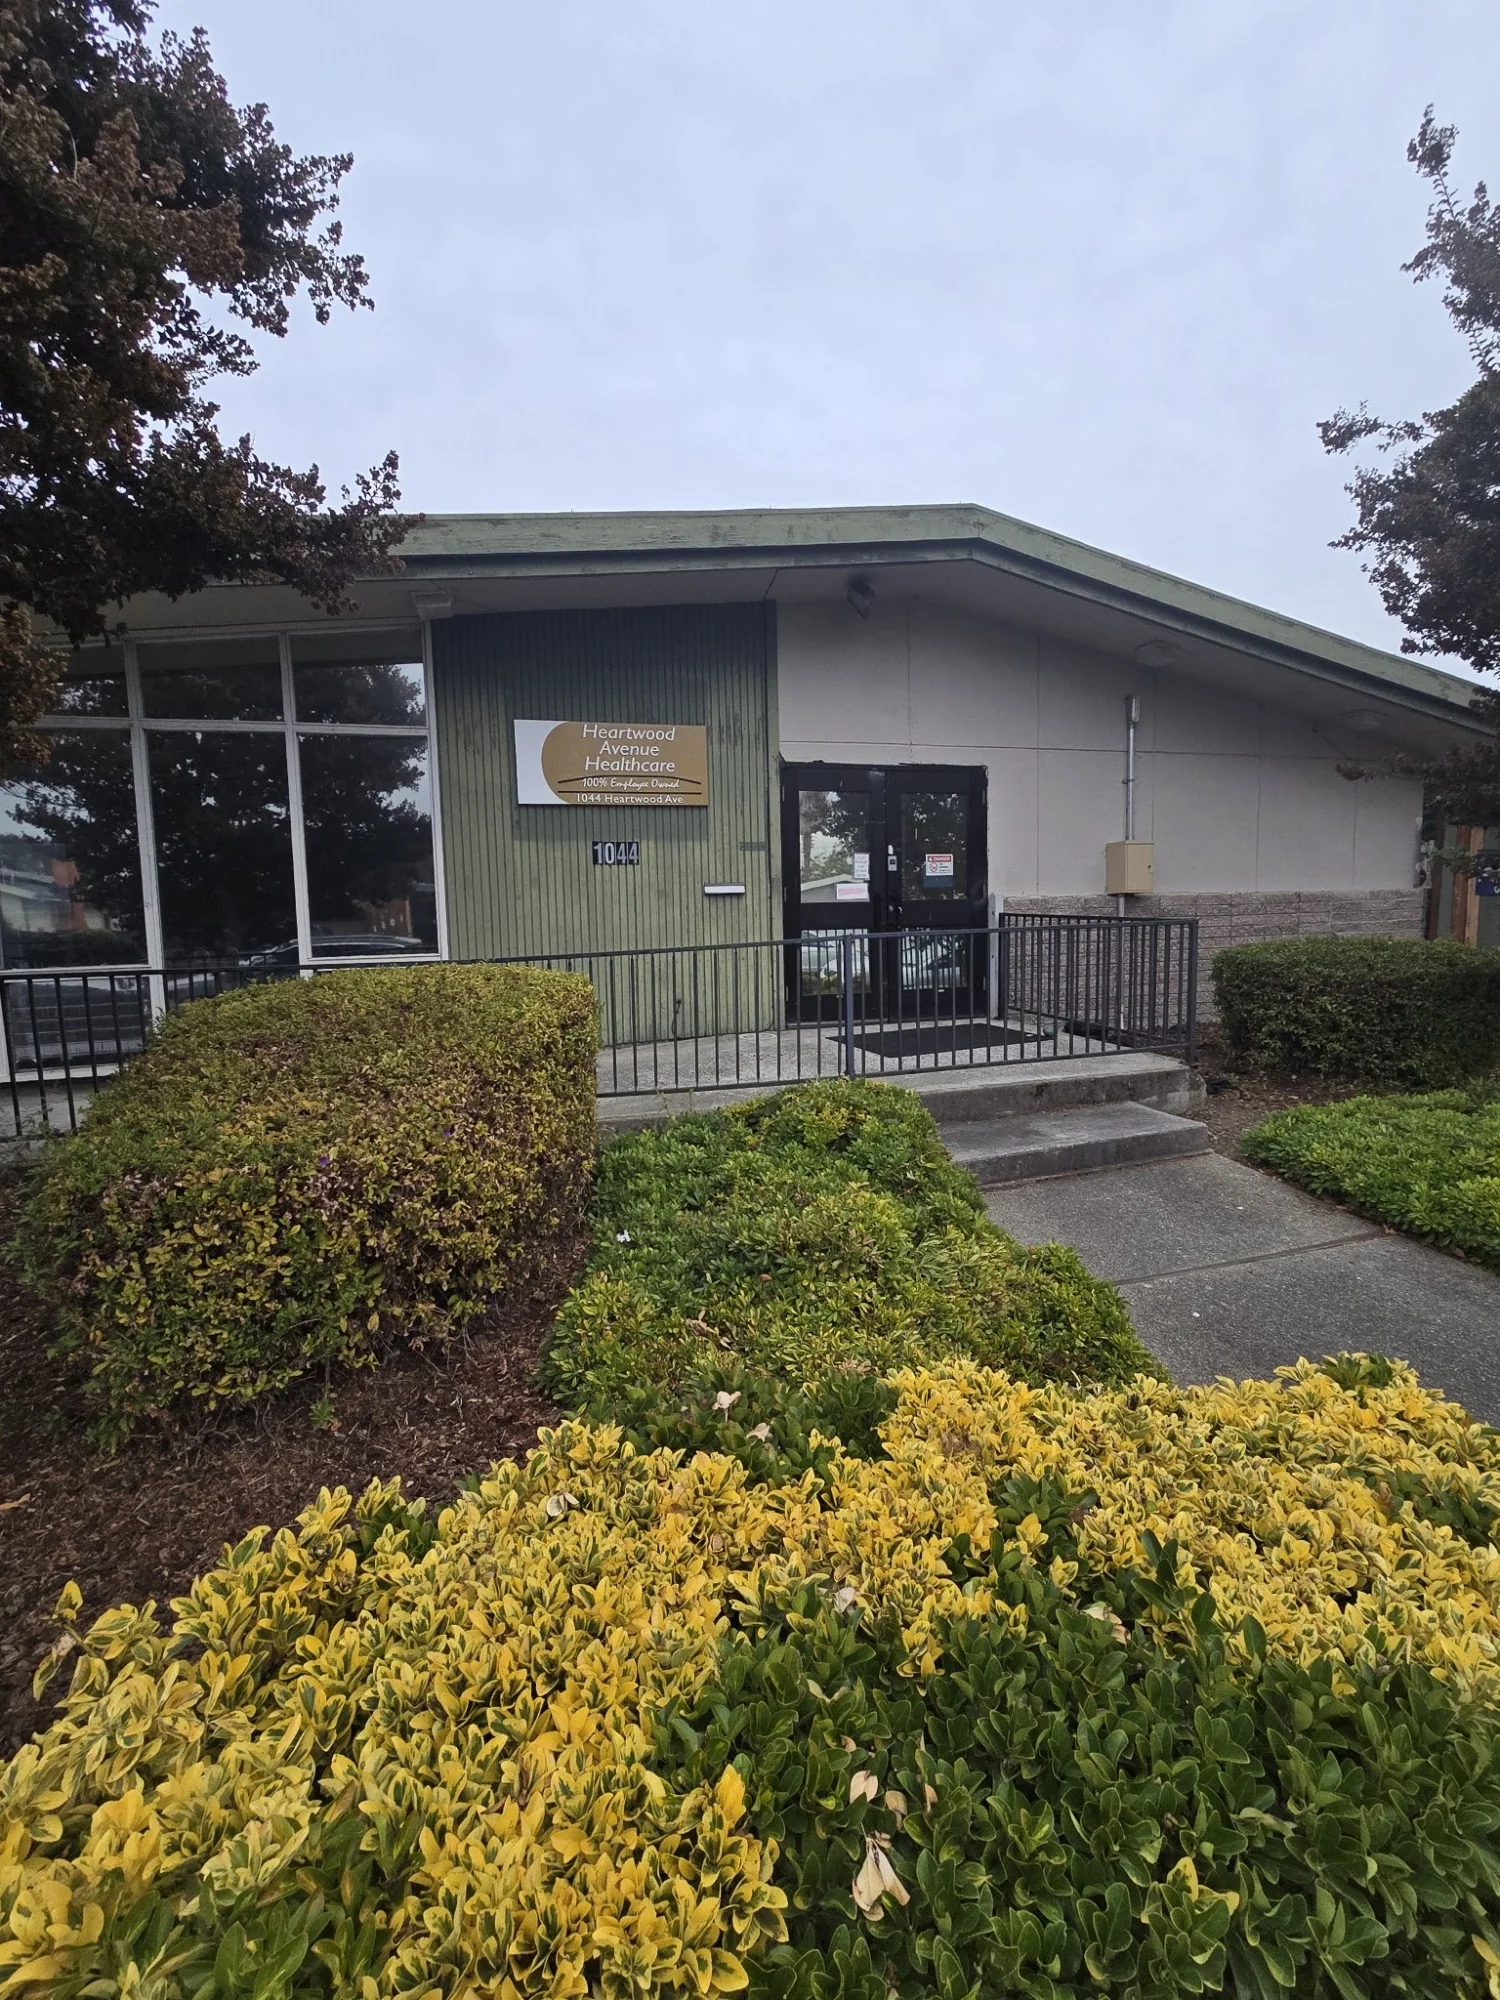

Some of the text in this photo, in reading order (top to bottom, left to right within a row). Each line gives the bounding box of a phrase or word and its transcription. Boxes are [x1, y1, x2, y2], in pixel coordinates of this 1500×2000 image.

[582, 723, 676, 741] Heartwood
[599, 740, 660, 757] Avenue
[584, 756, 676, 773] Healthcare
[581, 777, 680, 791] 100% Employee Owned
[576, 793, 601, 803] 1044
[604, 794, 663, 804] Heartwood
[593, 842, 639, 864] 1044
